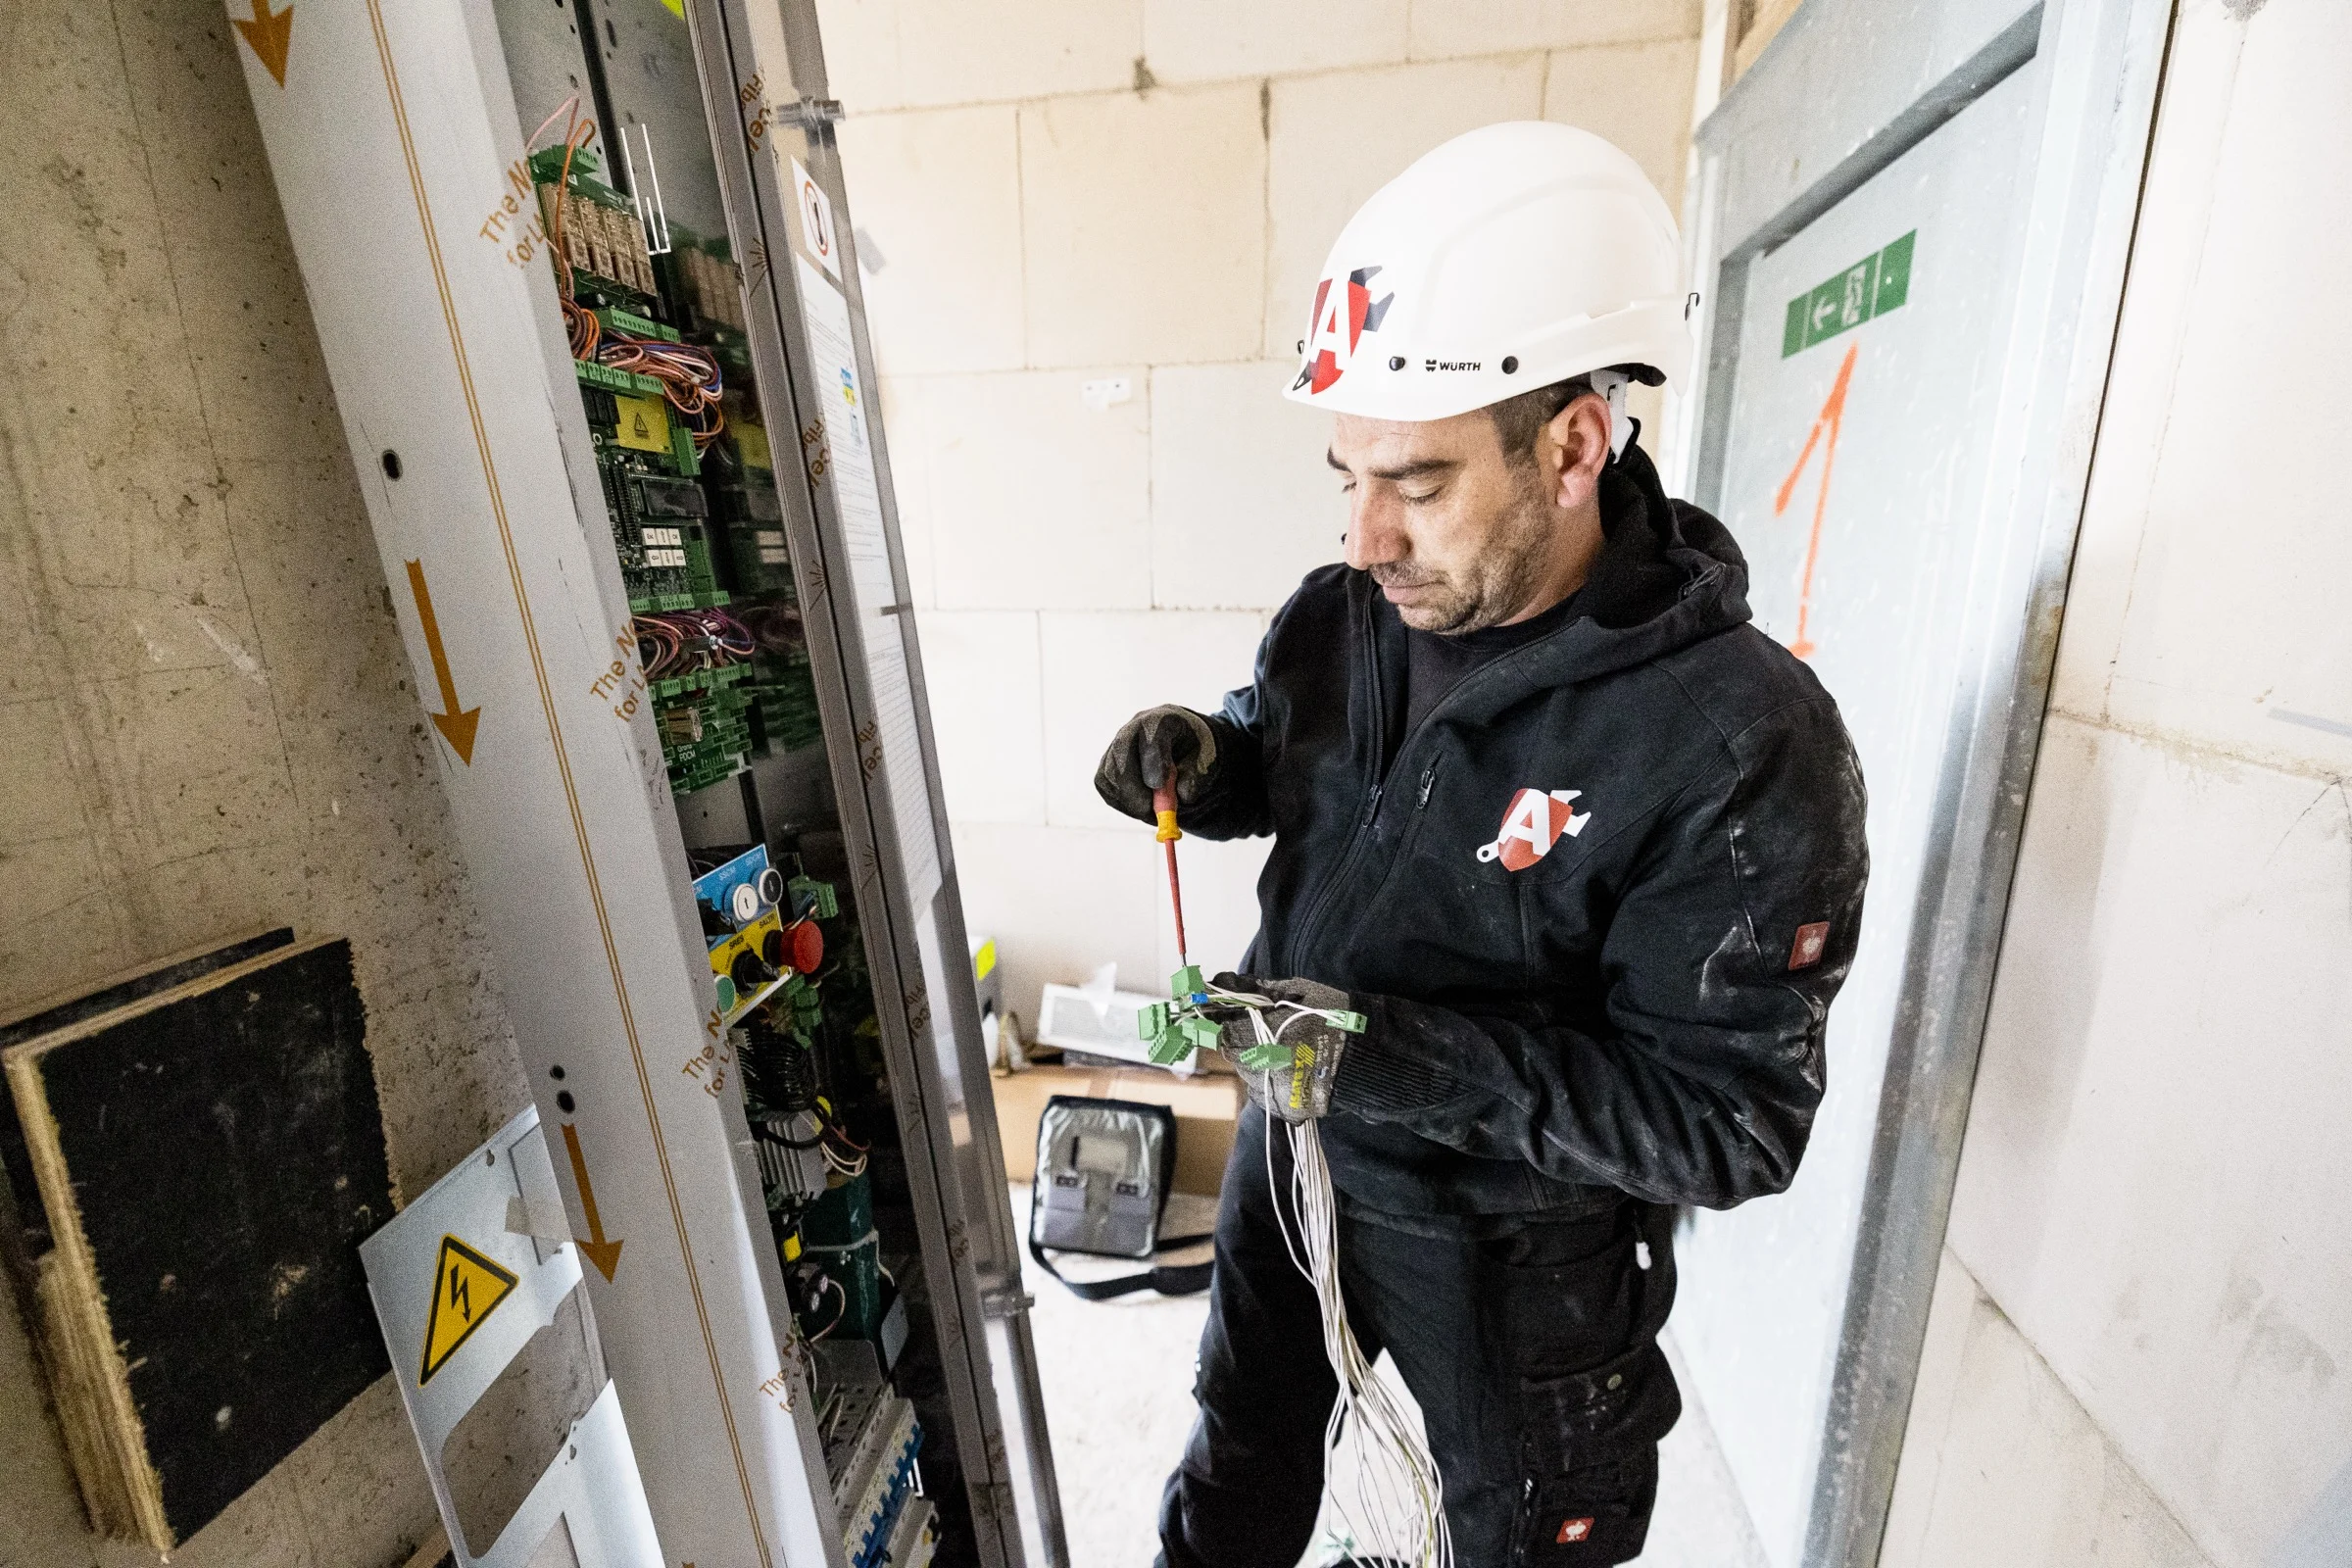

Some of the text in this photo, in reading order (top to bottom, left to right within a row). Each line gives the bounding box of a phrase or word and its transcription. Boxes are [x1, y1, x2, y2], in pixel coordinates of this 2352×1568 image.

[479, 194, 519, 244] The
[1440, 362, 1481, 371] WÜRTH
[590, 661, 626, 700] The
[613, 690, 640, 723] for
[682, 1045, 715, 1080] The
[705, 1067, 726, 1099] for
[759, 1368, 789, 1397] The
